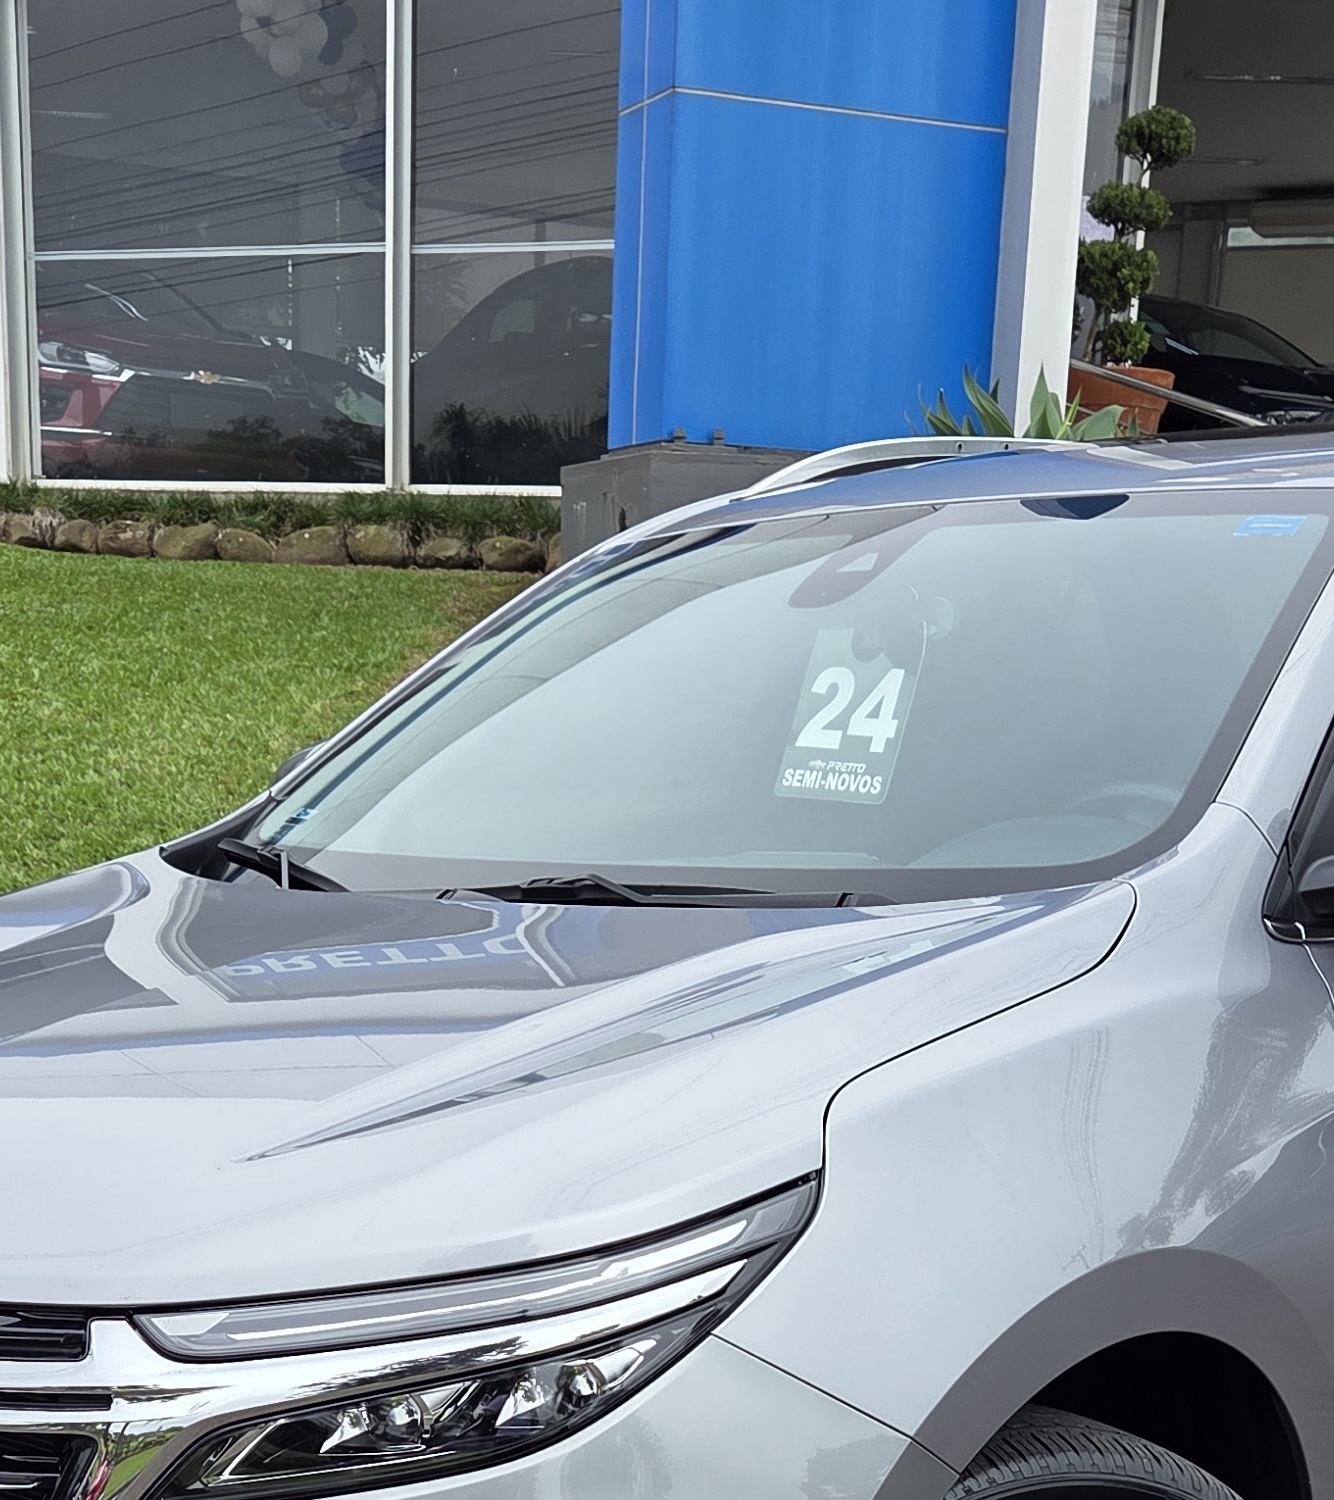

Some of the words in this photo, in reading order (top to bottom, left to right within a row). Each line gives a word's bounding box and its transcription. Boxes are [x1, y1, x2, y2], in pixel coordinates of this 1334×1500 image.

[795, 666, 905, 753] 24
[827, 761, 866, 773] PRETTO
[782, 768, 883, 794] SEMI-NOVOS
